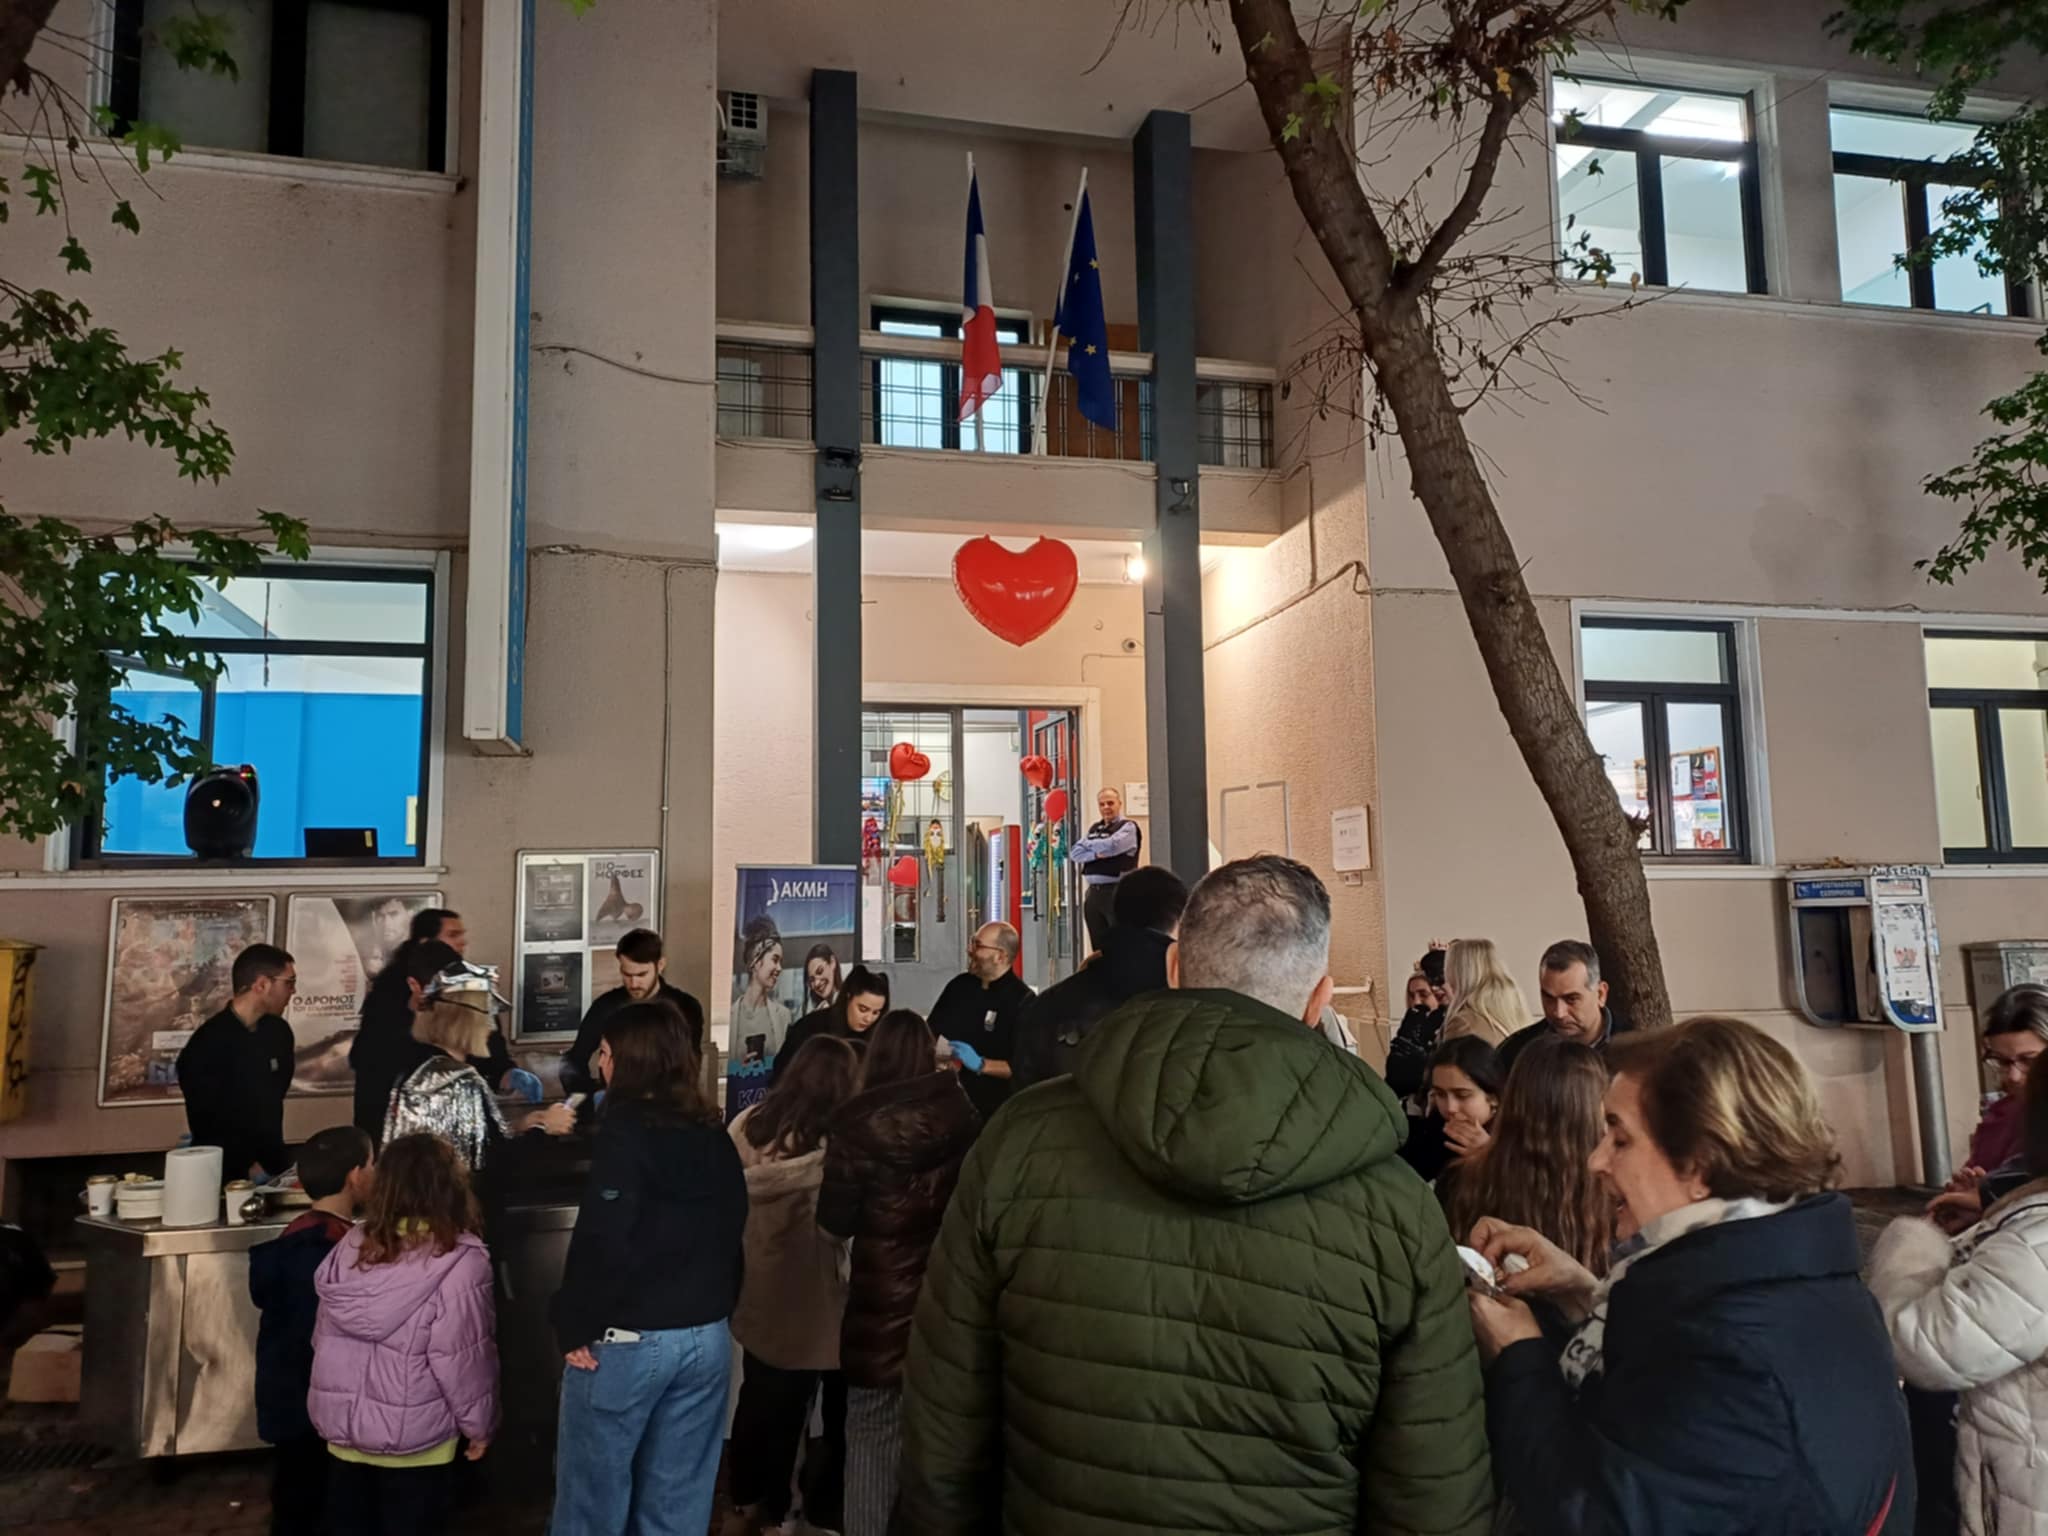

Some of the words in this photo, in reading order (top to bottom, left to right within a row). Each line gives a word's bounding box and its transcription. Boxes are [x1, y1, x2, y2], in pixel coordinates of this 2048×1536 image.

[595, 869, 645, 880] ΜΟΡΦΕΣ
[780, 881, 828, 897] ΑΚΜΗ
[293, 996, 303, 1005] Ο
[738, 1087, 769, 1109] ΚΑ
